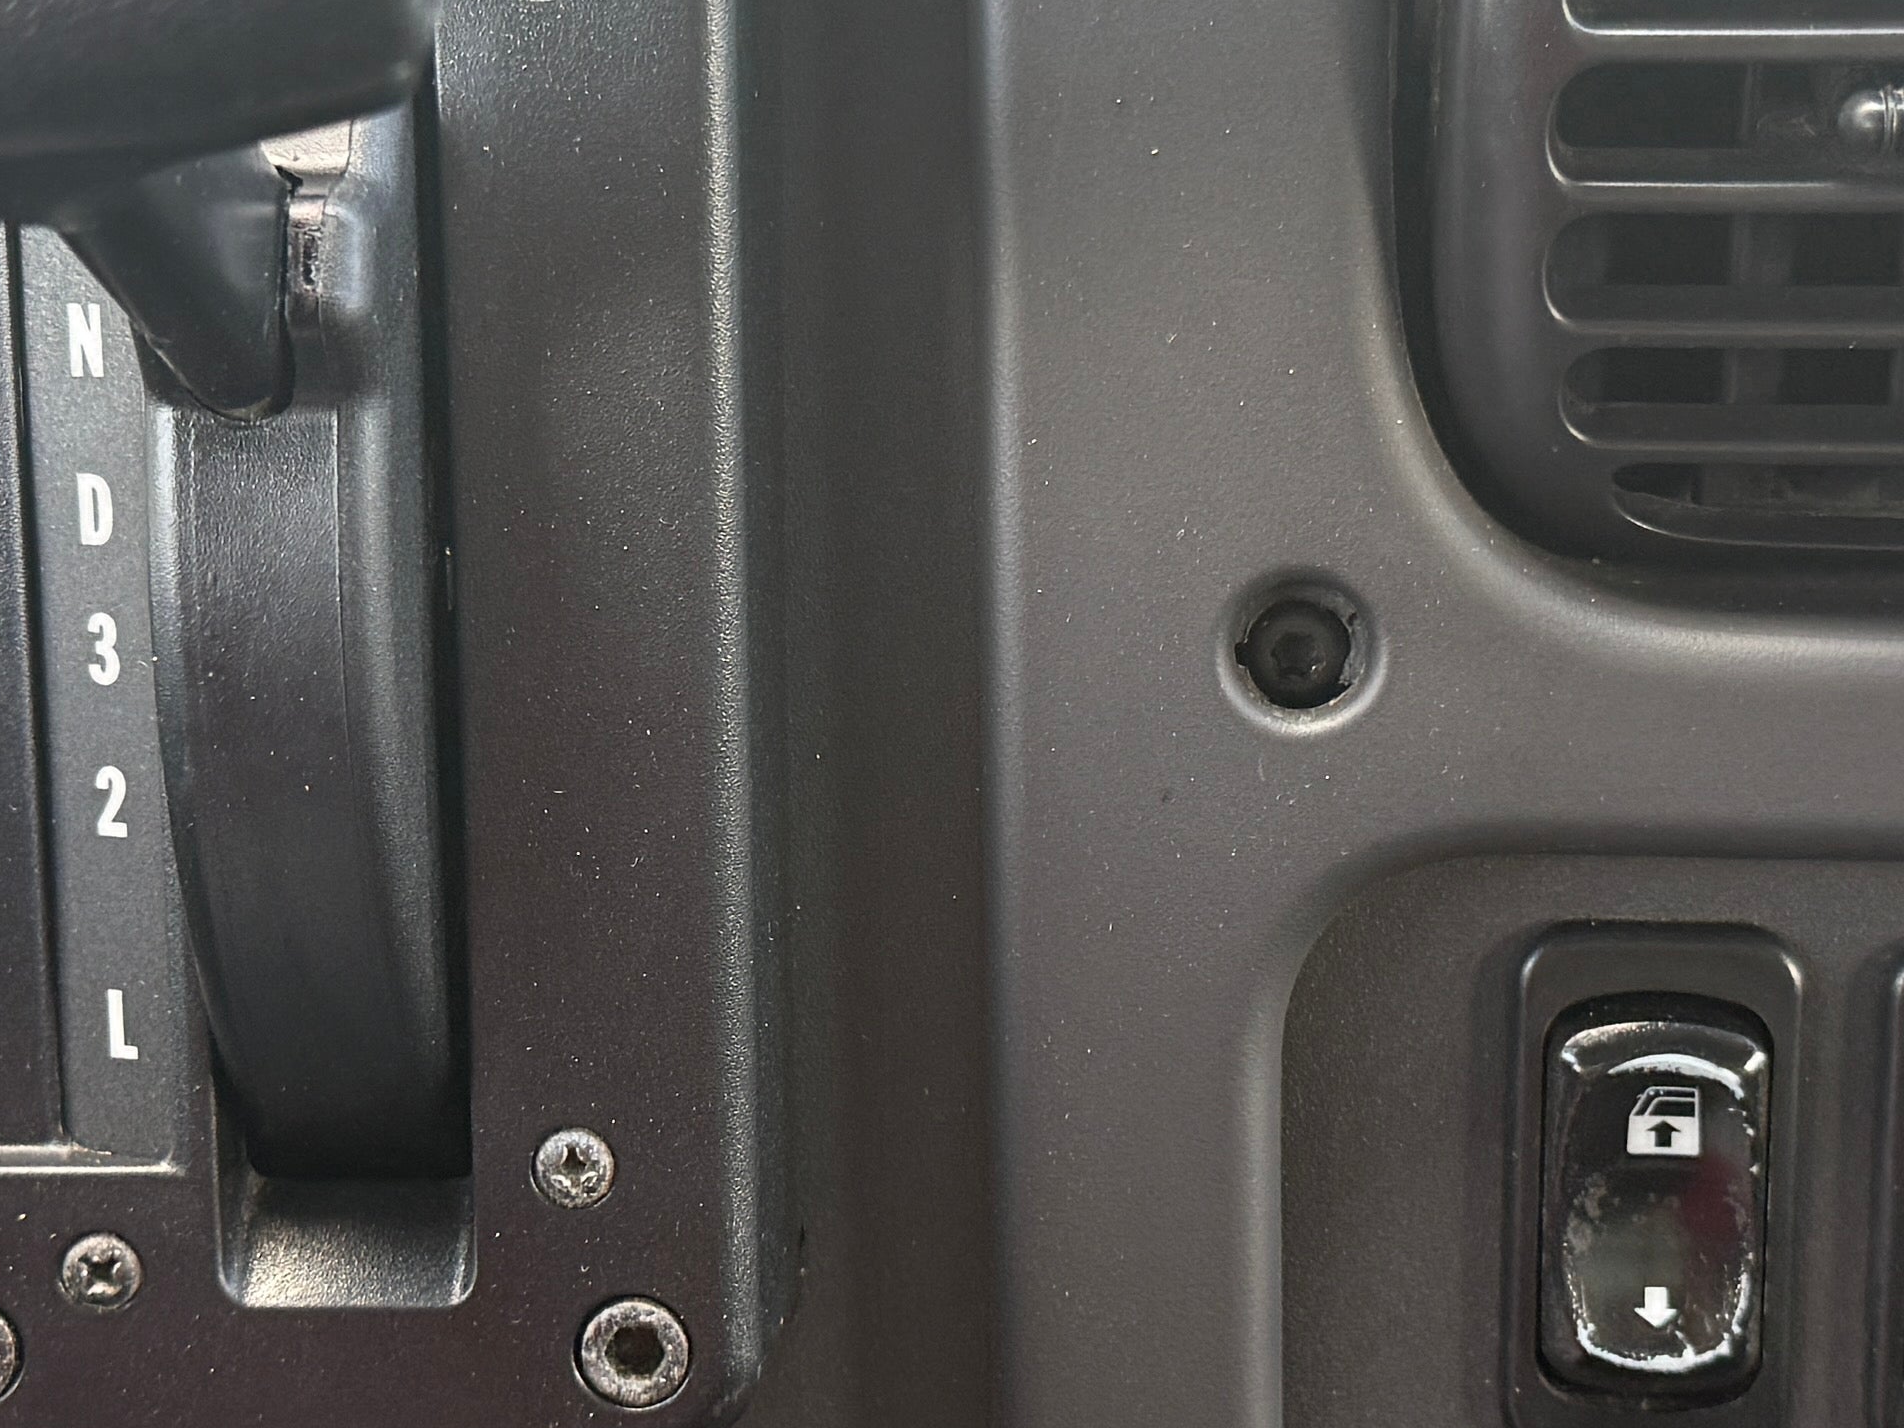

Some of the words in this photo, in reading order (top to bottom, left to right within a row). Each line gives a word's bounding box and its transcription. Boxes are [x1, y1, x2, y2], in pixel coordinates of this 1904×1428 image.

[66, 303, 105, 378] N
[76, 473, 114, 546] D
[87, 612, 121, 686] 3
[95, 766, 128, 838] 2
[107, 989, 139, 1060] L
